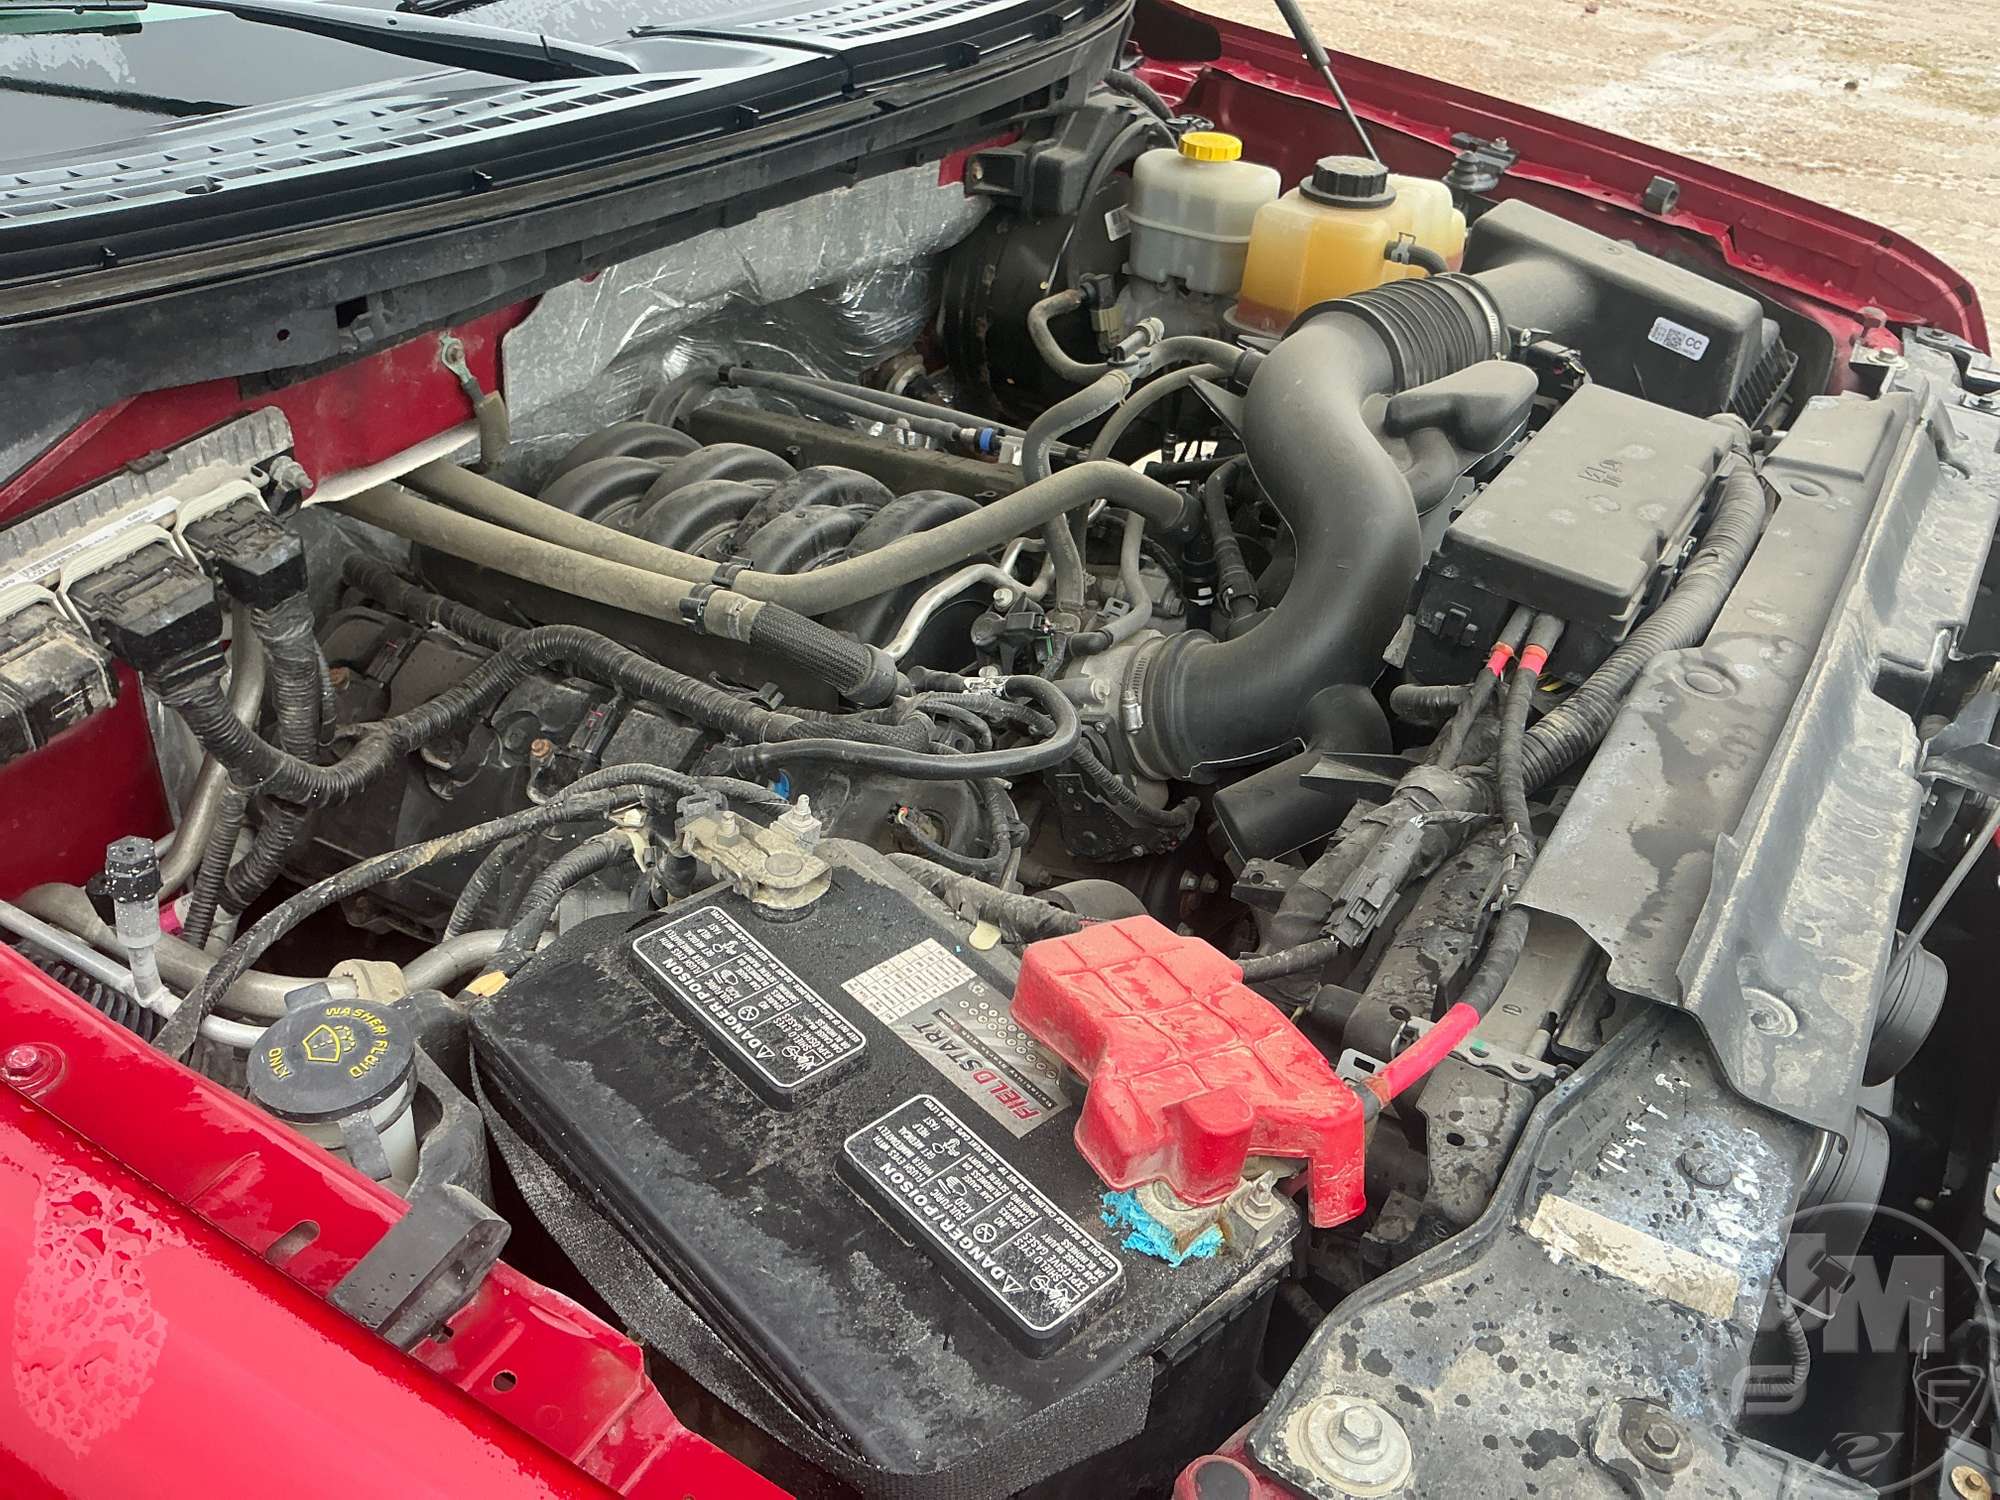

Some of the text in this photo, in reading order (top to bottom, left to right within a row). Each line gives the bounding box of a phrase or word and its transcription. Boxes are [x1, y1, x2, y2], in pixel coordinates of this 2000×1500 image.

[1685, 337, 1702, 350] CC
[669, 947, 688, 961] EYES
[659, 956, 764, 1049] DANGER/POISON
[702, 977, 735, 1004] SULFURIC
[771, 1016, 792, 1033] EYES
[779, 1012, 804, 1032] GASES
[268, 1007, 389, 1079] WASHER FLUID ONLY
[786, 1030, 813, 1052] SHIELD
[798, 1029, 835, 1060] EXPLOSIVE
[910, 1120, 932, 1138] HELP
[921, 1115, 941, 1131] FAST
[875, 1123, 935, 1177] WATER IMMEDIATELY
[895, 1124, 937, 1160] GET MEDICAL
[871, 1134, 926, 1183] FLUSH EYES WITH
[966, 1154, 1010, 1193] SEVERE INJURY
[960, 1160, 1003, 1198] BLINDNESS OR
[961, 1173, 995, 1202] CAN CAUSE
[927, 1187, 966, 1221] SULFURIC
[952, 1196, 975, 1215] ACID
[996, 1206, 1024, 1229] SPARKS
[1003, 1200, 1031, 1224] FLAMES
[1008, 1192, 1040, 1219] SMOKING
[877, 1161, 1007, 1280] DANGER/POISON
[992, 1215, 1008, 1229] NO
[1012, 1236, 1063, 1282] SHIELD EYES
[1020, 1231, 1090, 1292] EXPLOSIVE GASES
[1039, 1231, 1099, 1284] CAN CAUSE INJURY
[1059, 1237, 1107, 1279] OR BLINDNESS
